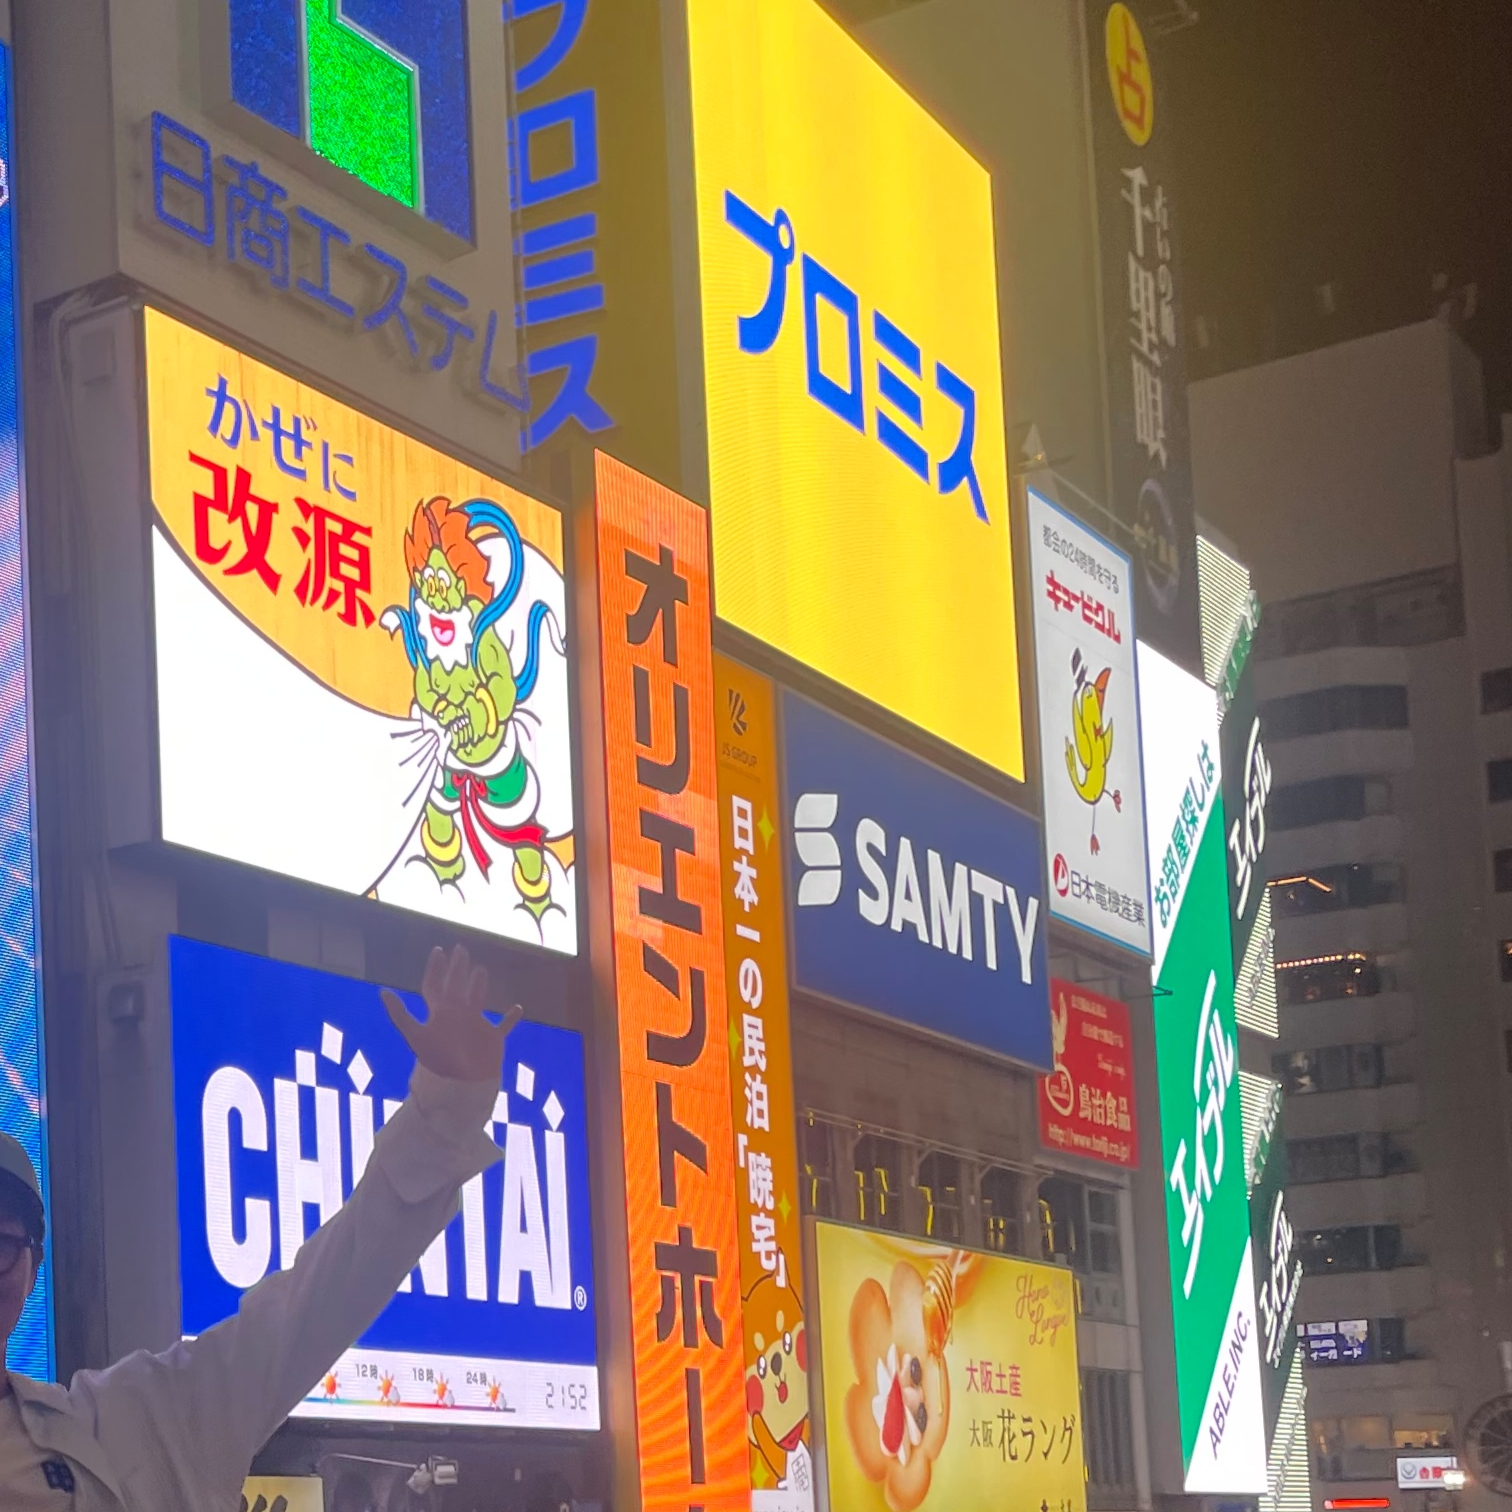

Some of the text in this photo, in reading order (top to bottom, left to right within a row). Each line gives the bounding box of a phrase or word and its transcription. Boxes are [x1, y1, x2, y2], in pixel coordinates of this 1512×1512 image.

[724, 188, 991, 526] プロミス
[1119, 165, 1168, 471] 千里眼
[204, 372, 357, 501] かぜに
[187, 449, 379, 628] 改源
[1045, 568, 1122, 645] キュービクル
[1153, 738, 1216, 930] お部屋探しは
[1228, 737, 1272, 891] エイブル
[854, 815, 1040, 986] SAMTY
[1070, 869, 1146, 929] 日本電機産業
[731, 794, 787, 1289] 日本一の民泊「暁宅」
[1169, 1000, 1235, 1252] エイブル
[354, 1363, 378, 1380] 12時
[412, 1366, 435, 1384] 18時
[465, 1371, 488, 1387] 24時
[965, 1358, 1023, 1398] 大阪土産
[1209, 1310, 1252, 1461] ABLE.INC.
